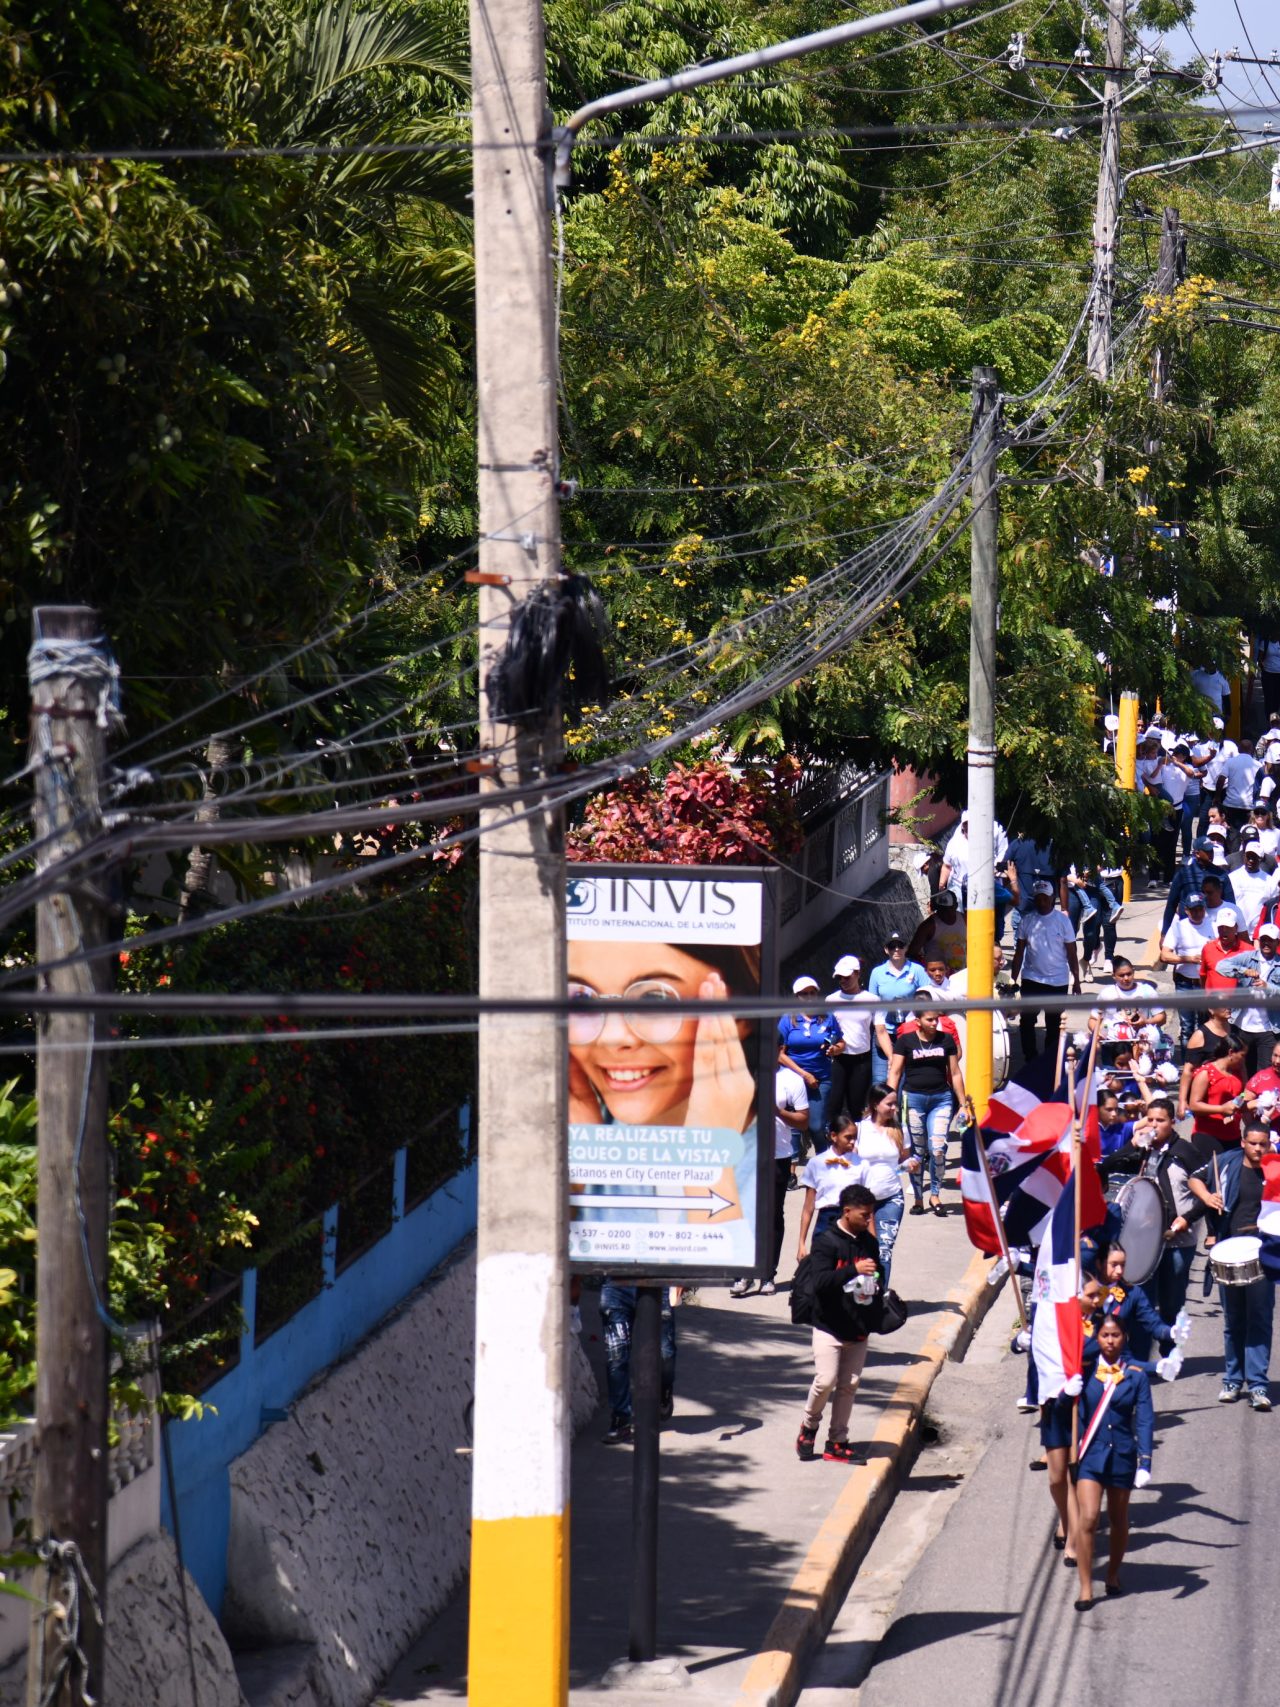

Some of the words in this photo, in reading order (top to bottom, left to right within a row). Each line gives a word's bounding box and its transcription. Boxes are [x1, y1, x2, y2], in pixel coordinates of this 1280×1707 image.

[611, 879, 736, 916] INVIS
[602, 919, 674, 928] INTERNACIONAL
[677, 921, 689, 929] DE
[692, 921, 704, 929] LA
[595, 1128, 687, 1144] REALIZASTE
[692, 1130, 712, 1144] TU
[627, 1148, 647, 1161] DE
[653, 1149, 673, 1162] LA
[677, 1149, 731, 1163] VISTA?
[610, 1170, 623, 1179] en
[625, 1168, 645, 1182] City
[648, 1169, 681, 1180] Center
[684, 1169, 714, 1182] Plaza!
[582, 1229, 597, 1237] 537
[608, 1230, 631, 1238] 0200
[648, 1231, 665, 1239] 809
